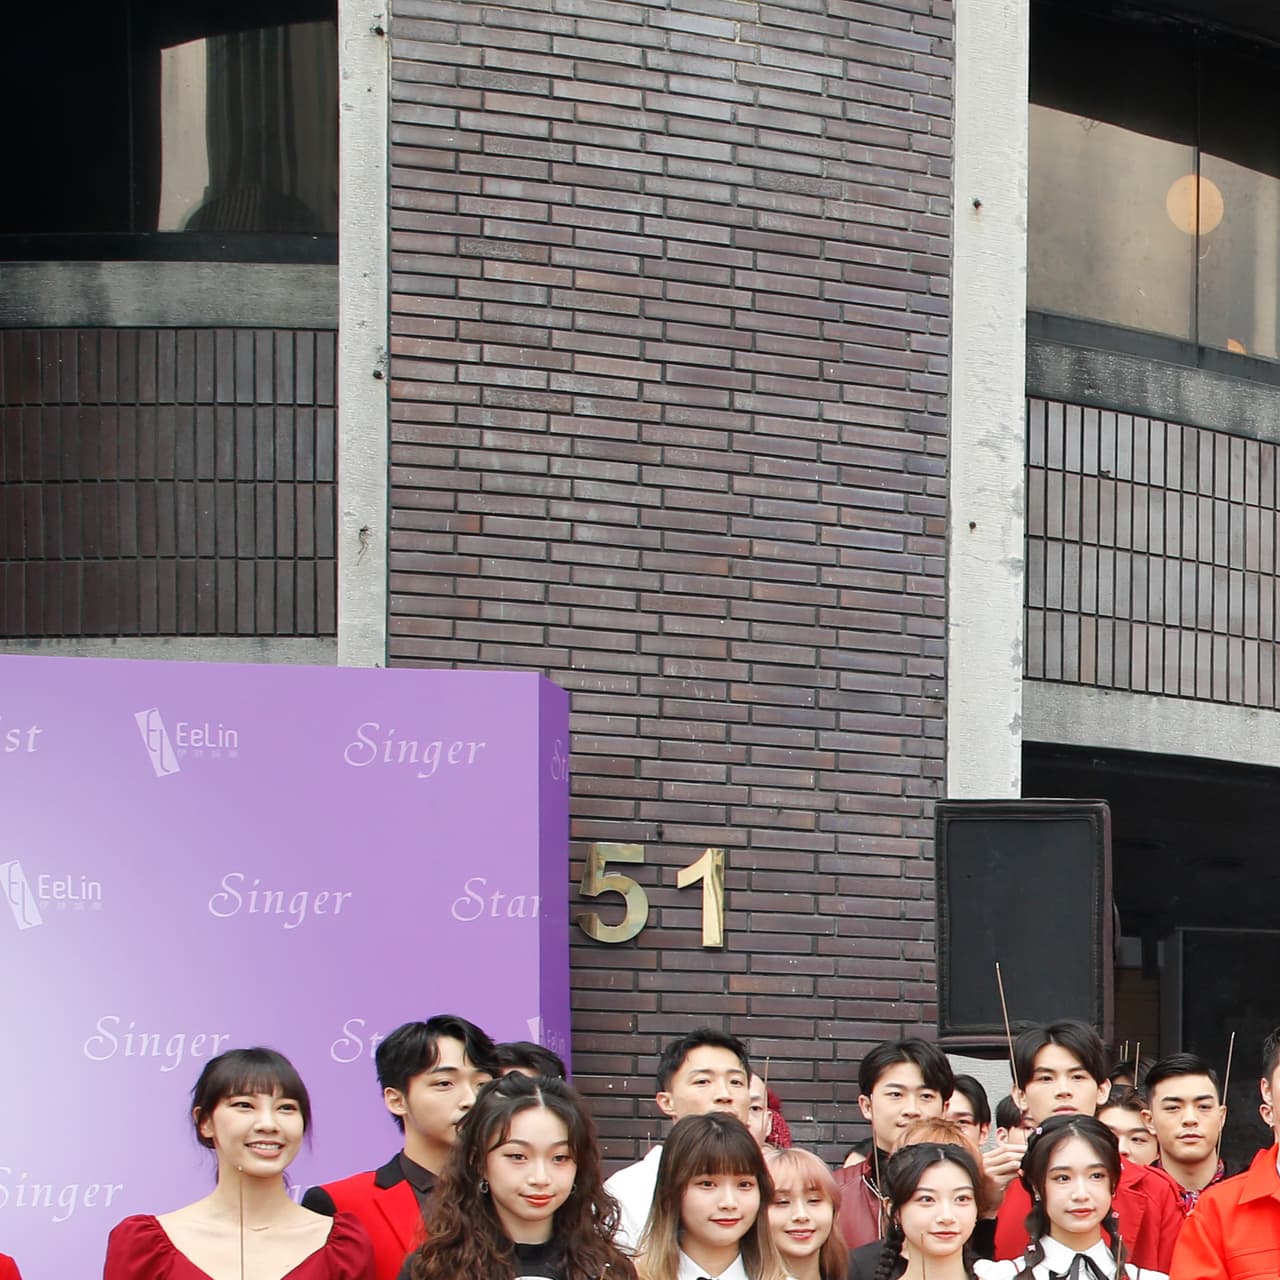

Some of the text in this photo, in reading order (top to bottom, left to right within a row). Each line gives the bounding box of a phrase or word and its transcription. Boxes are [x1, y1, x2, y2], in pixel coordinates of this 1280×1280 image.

[176, 722, 239, 748] EeLin
[344, 722, 486, 779] Singer
[38, 874, 102, 902] EeLin
[208, 873, 352, 929] Singer
[451, 877, 543, 922] Star
[577, 842, 727, 949] 51
[83, 1016, 230, 1072] Singer
